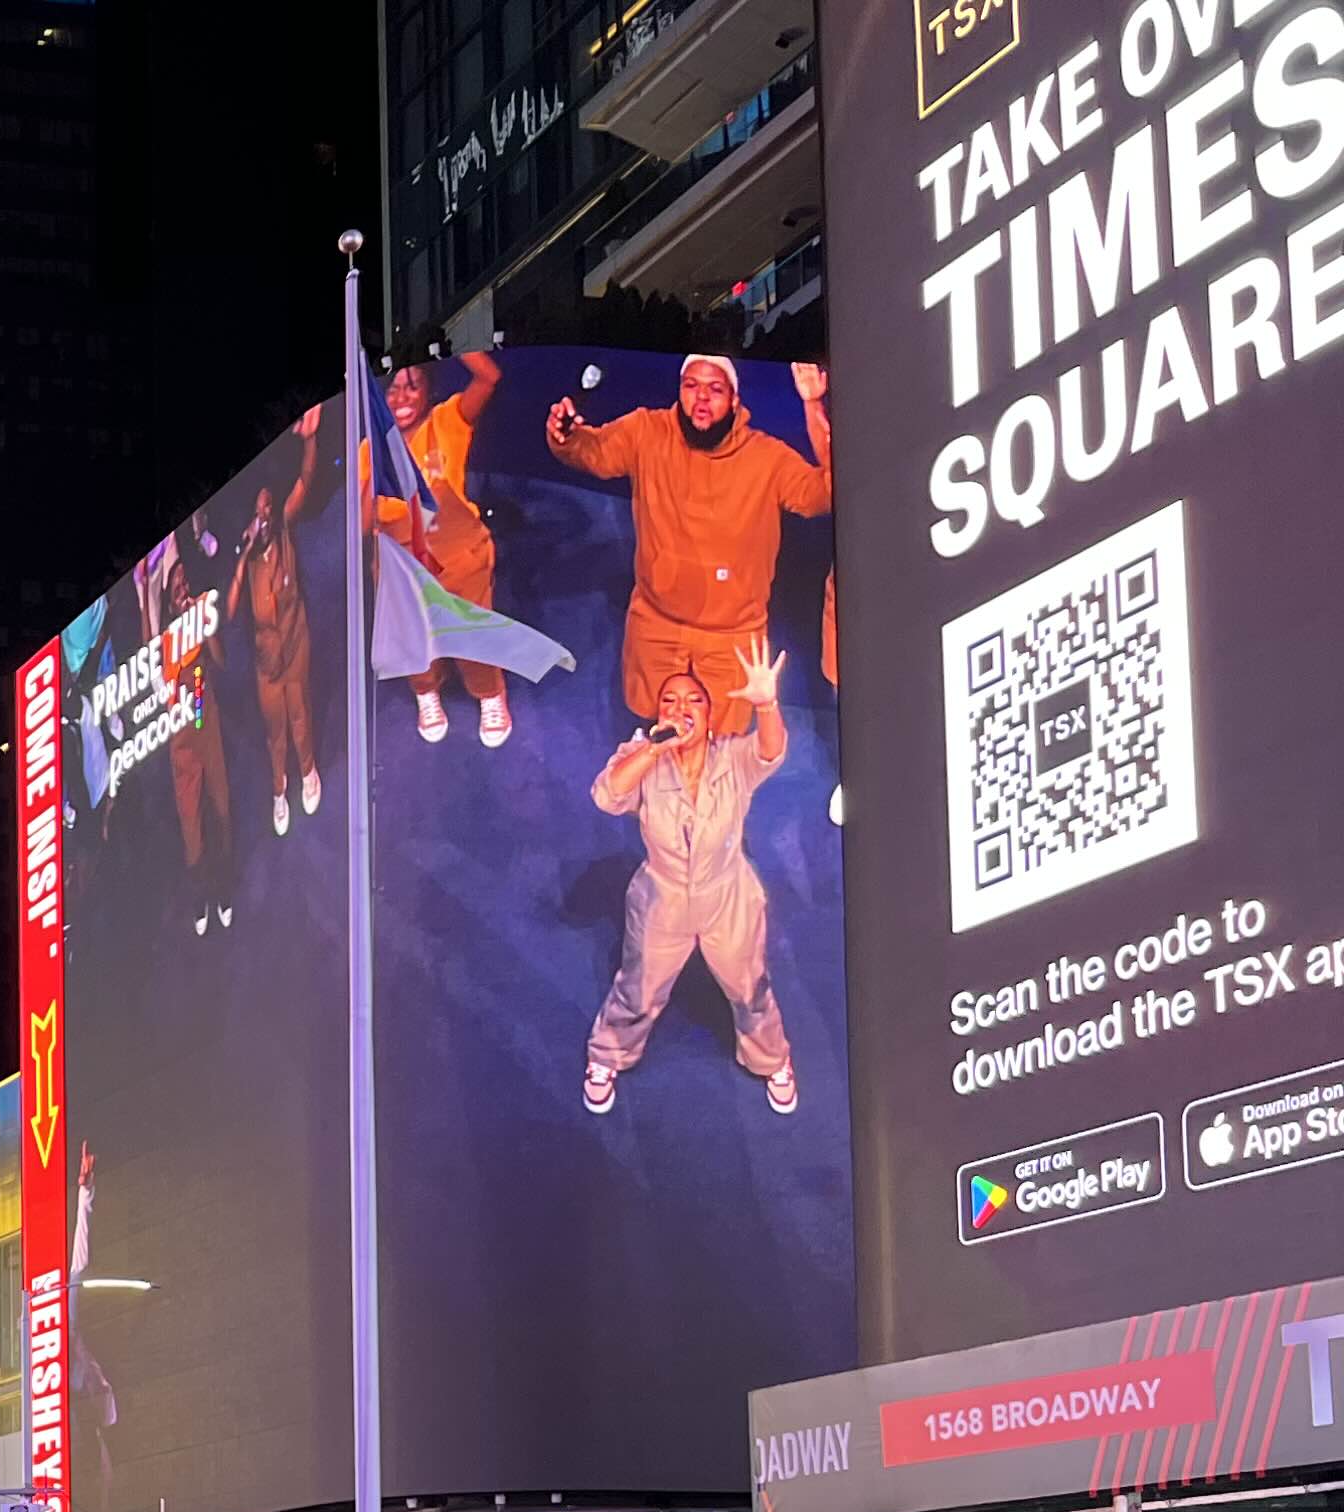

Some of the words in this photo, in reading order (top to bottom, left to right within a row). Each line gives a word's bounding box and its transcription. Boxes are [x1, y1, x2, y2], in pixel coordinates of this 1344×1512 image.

[917, 40, 1104, 243] TAKE
[922, 6, 1344, 408] TIMES
[928, 202, 1344, 559] SQUARE
[92, 634, 162, 727] PRAISE
[168, 588, 220, 665] THIS
[132, 692, 160, 726] ONLY
[159, 679, 176, 705] ON
[23, 653, 58, 807] COME
[108, 683, 196, 798] peacock
[1039, 703, 1087, 747] TSX
[950, 977, 1040, 1036] Scan
[1046, 957, 1106, 1011] the
[1113, 913, 1213, 981] code
[1222, 897, 1266, 946] to
[951, 1003, 1124, 1095] download
[1132, 988, 1196, 1039] the
[1203, 944, 1296, 1016] TSX
[1242, 1086, 1321, 1124] Download
[1322, 1083, 1343, 1105] on
[1243, 1117, 1303, 1162] App
[1015, 1157, 1040, 1180] GET
[1040, 1154, 1050, 1177] IT
[1050, 1150, 1073, 1174] ON
[1015, 1169, 1099, 1214] Google
[1100, 1155, 1150, 1200] Play
[924, 1399, 984, 1443] 1568
[991, 1378, 1162, 1434] BROADWAY
